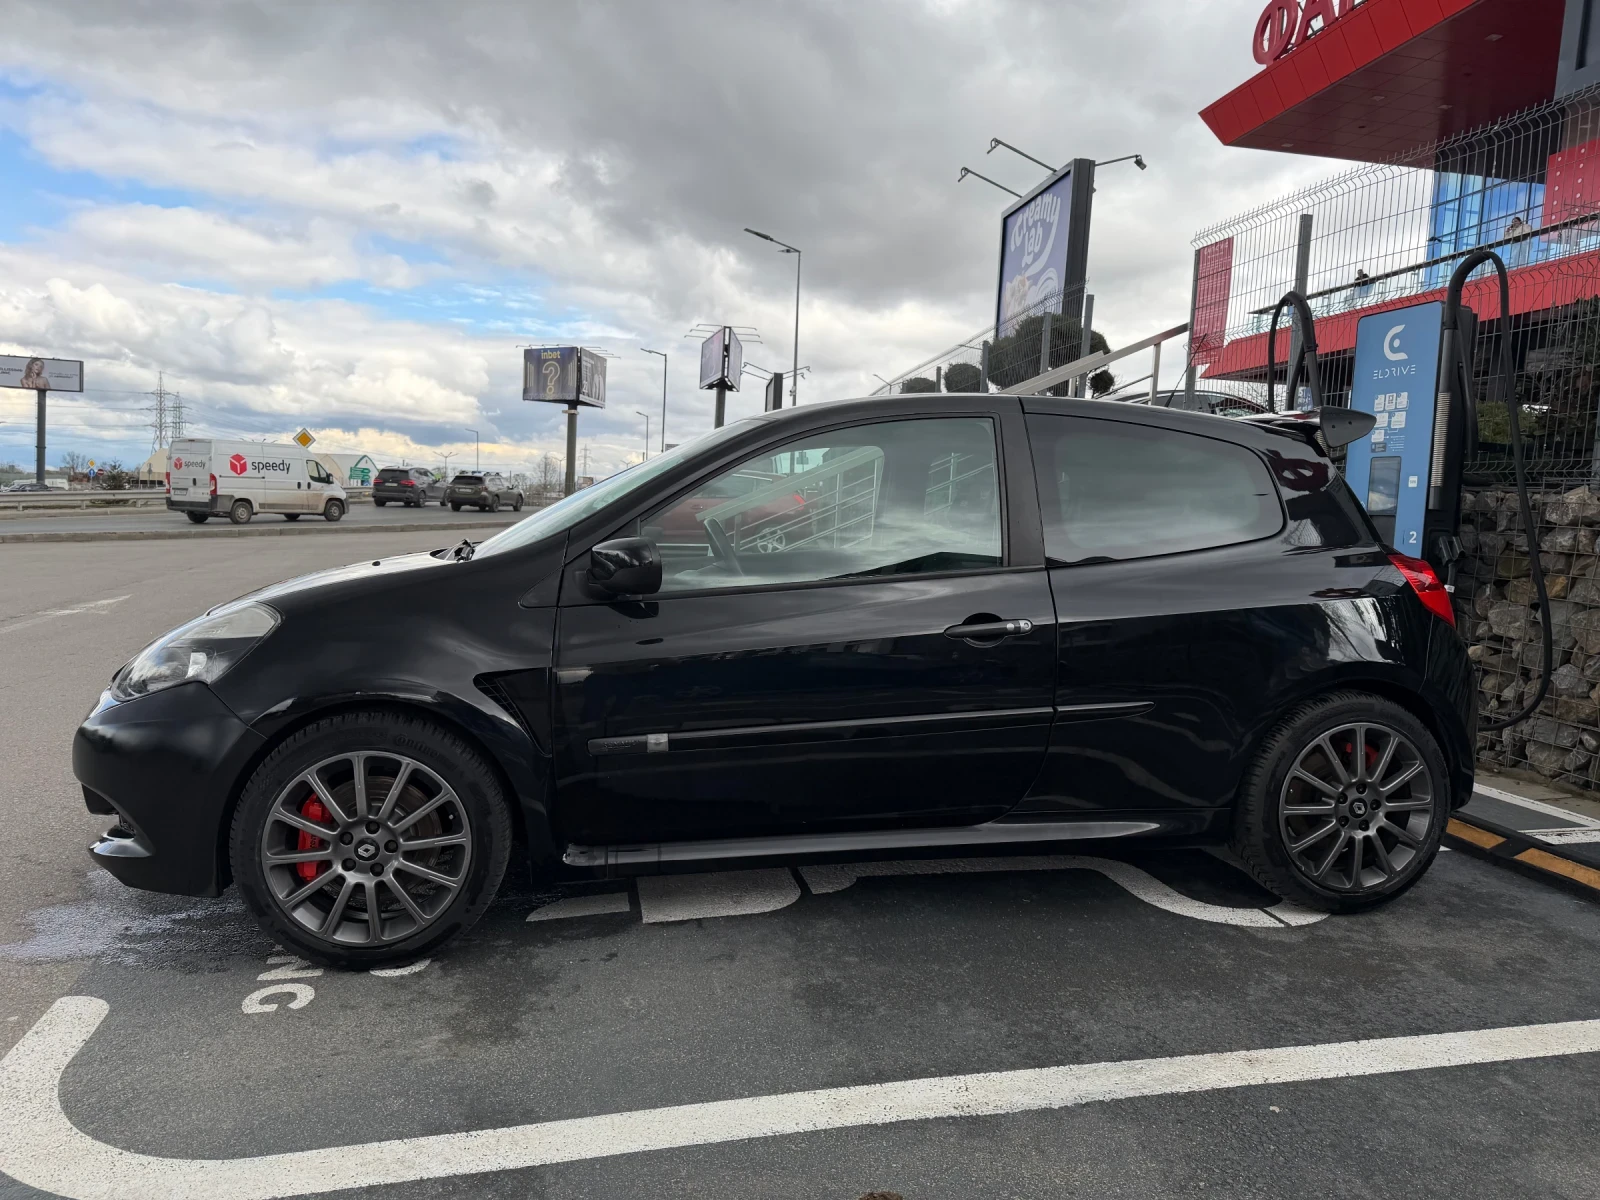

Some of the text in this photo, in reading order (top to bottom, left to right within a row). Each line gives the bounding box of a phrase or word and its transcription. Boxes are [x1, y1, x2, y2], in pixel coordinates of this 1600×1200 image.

[1022, 222, 1042, 267] Lab
[541, 349, 561, 359] inbet
[1373, 364, 1416, 379] ELDRIVE
[184, 460, 206, 469] speedy
[251, 460, 291, 474] speedy
[1408, 531, 1418, 544] 2
